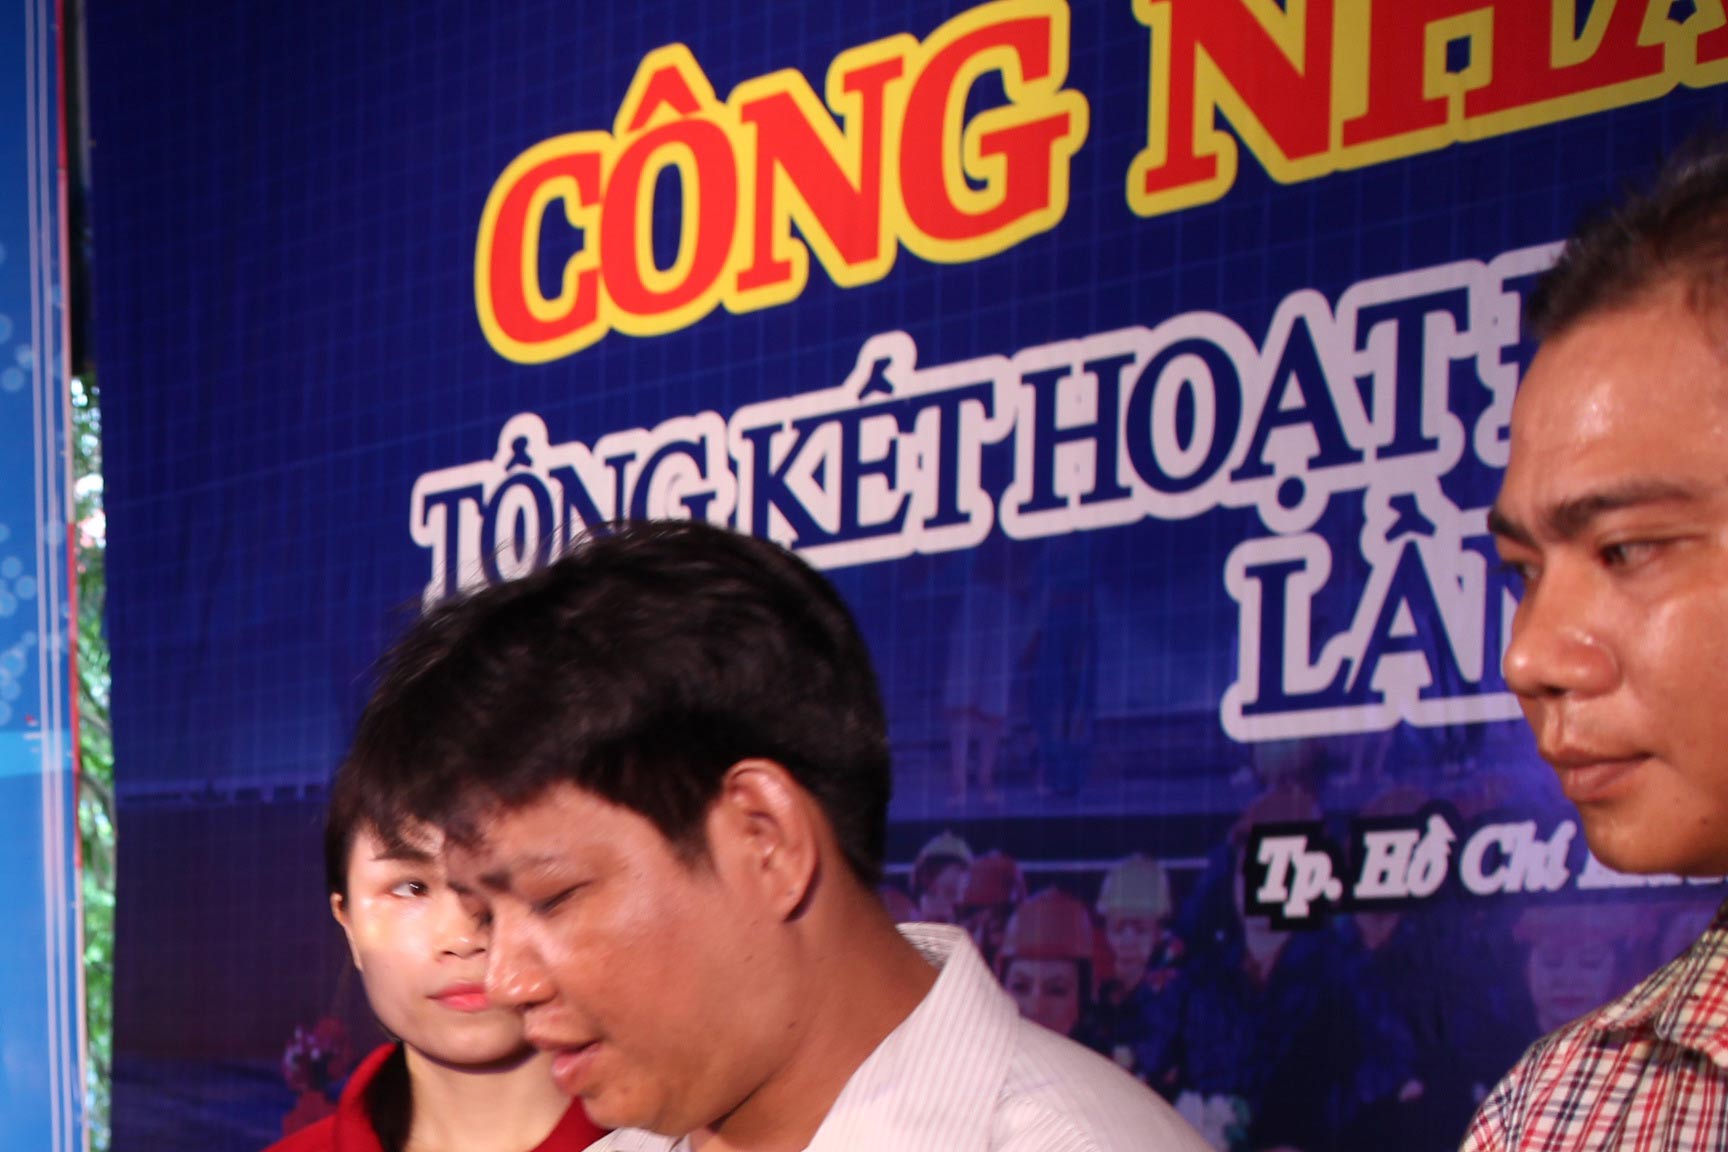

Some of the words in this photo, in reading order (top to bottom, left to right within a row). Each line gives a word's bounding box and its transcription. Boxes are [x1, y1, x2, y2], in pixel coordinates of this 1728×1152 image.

[480, 6, 1080, 354] CÔNG
[736, 345, 1001, 560] KẾT
[1010, 275, 1479, 525] HOẠT
[1256, 834, 1344, 919] Tp.
[1353, 812, 1457, 899] Hồ
